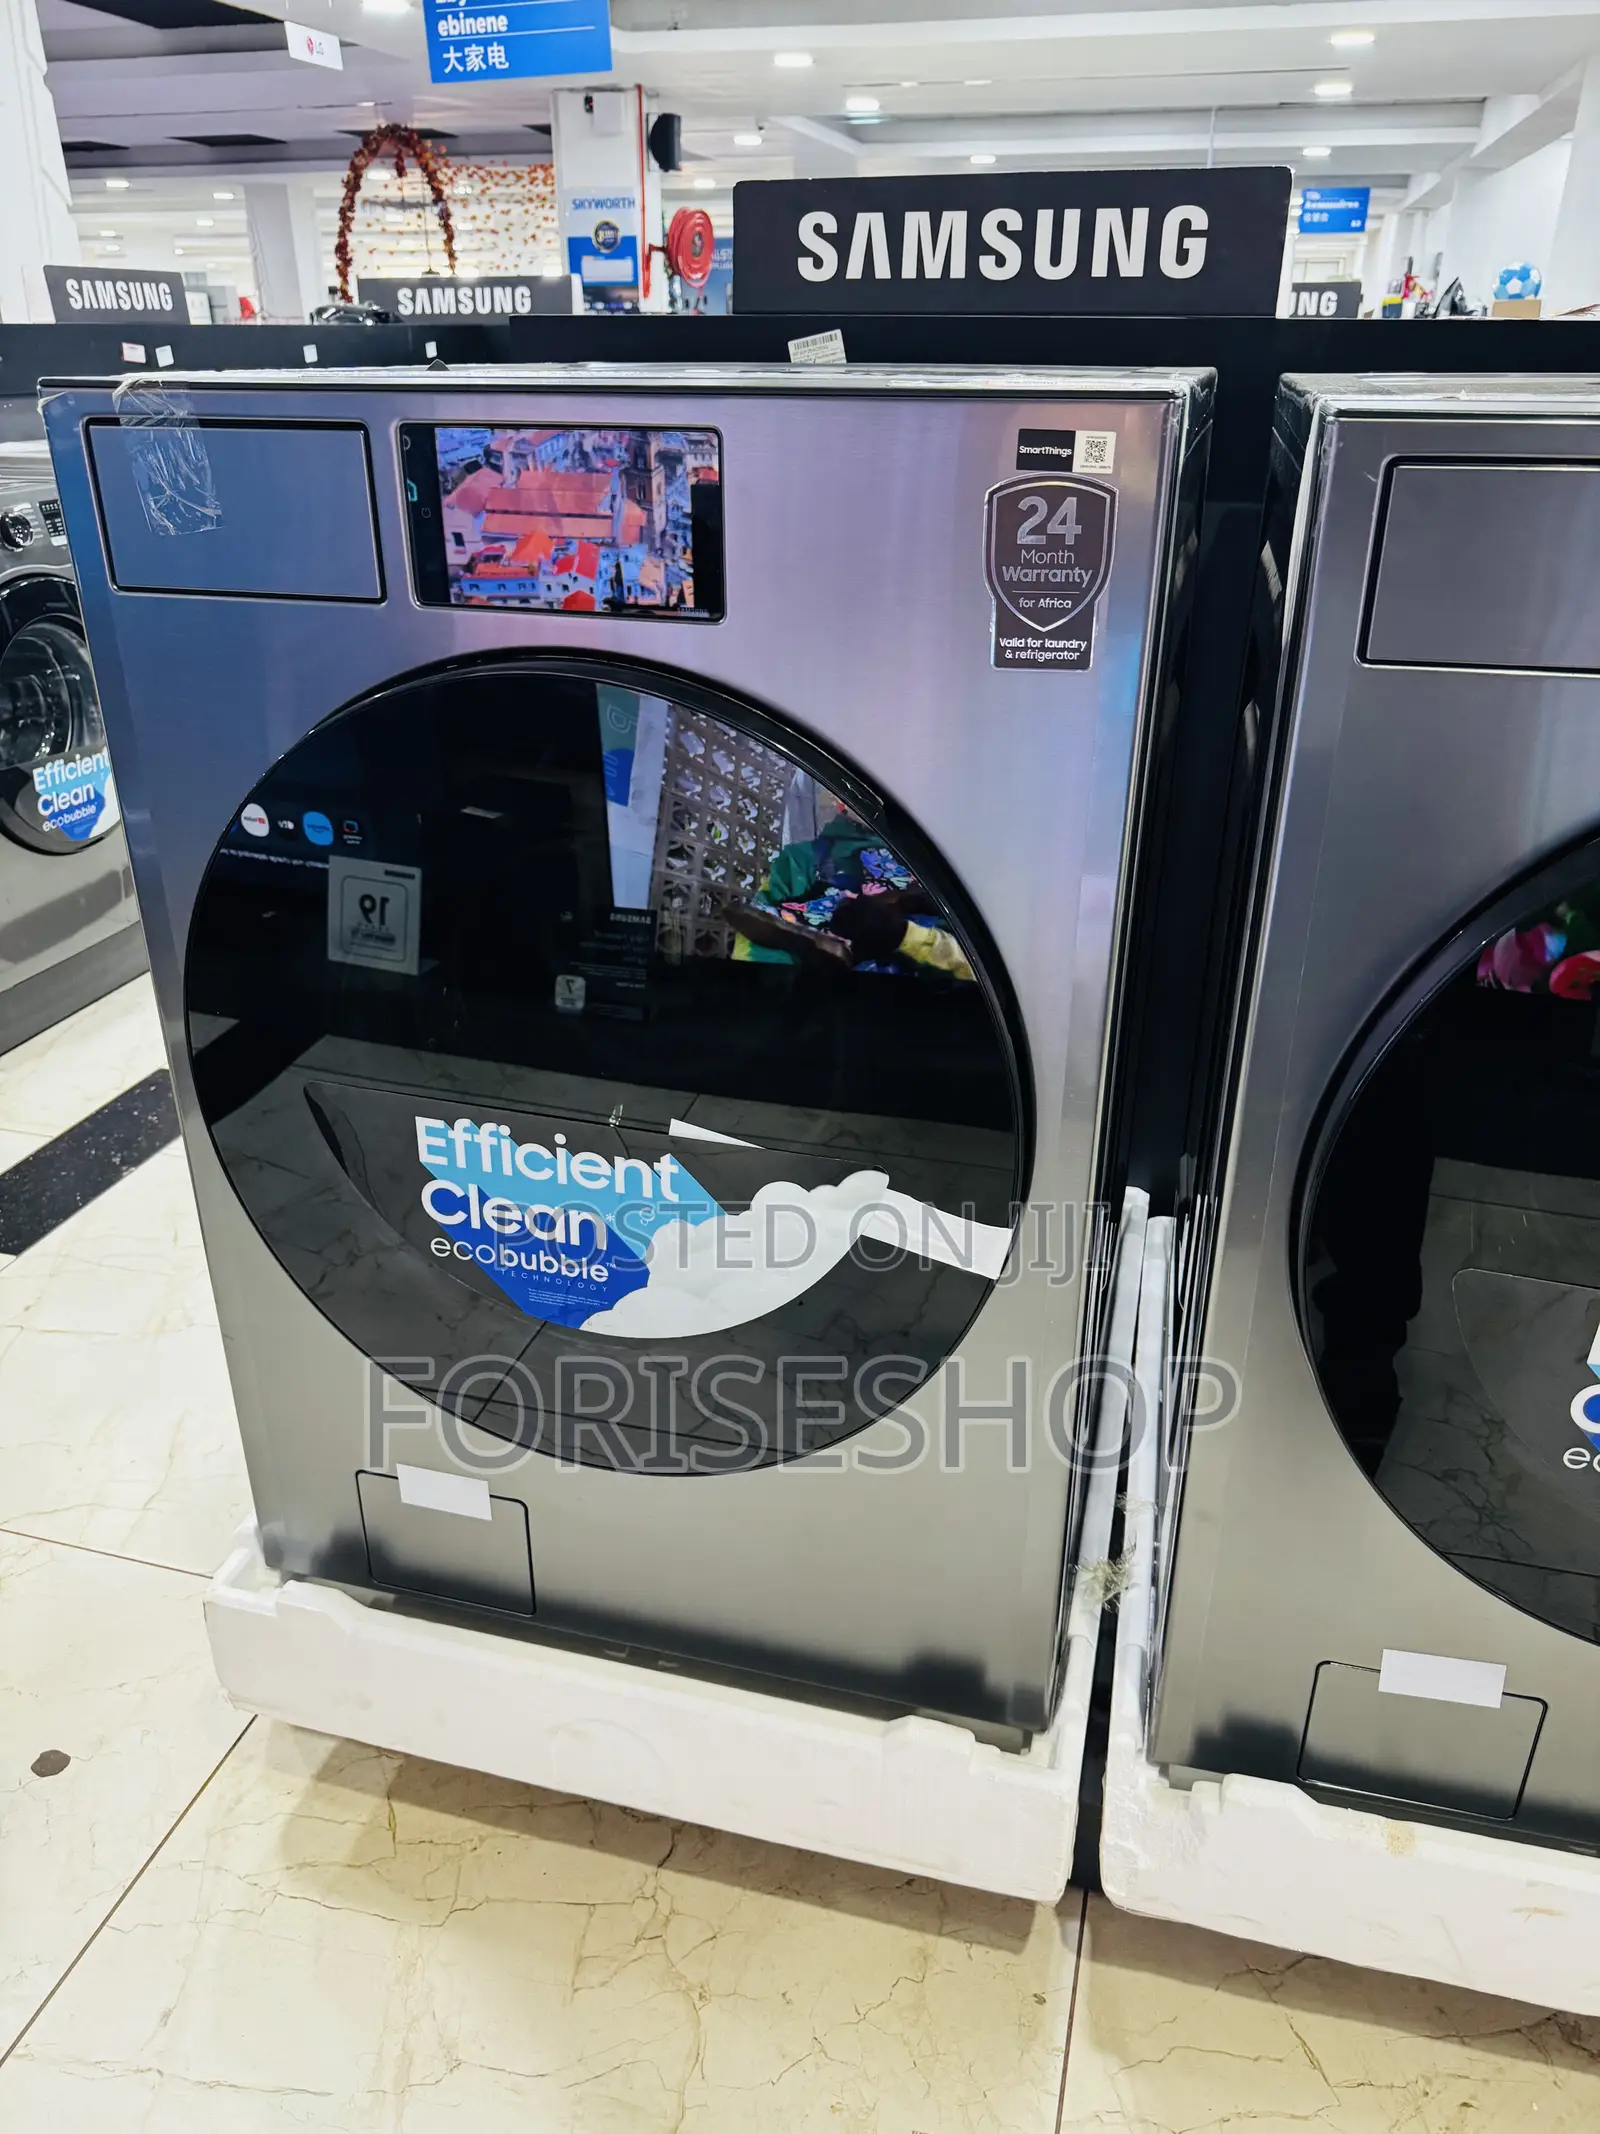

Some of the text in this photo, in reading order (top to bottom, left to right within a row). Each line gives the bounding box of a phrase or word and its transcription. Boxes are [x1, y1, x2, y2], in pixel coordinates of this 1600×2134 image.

[437, 12, 508, 37] ebinene
[442, 42, 509, 73] 大家电
[571, 197, 635, 210] SKYWORTH
[797, 204, 1209, 283] SAMSUNG
[65, 278, 174, 311] SAMSUNG
[397, 285, 532, 315] SAMSUNG
[1018, 445, 1073, 458] SmartThings
[1016, 495, 1083, 545] 24
[1020, 549, 1076, 565] Month
[1001, 565, 1093, 588] Warranty
[1018, 597, 1073, 609] for Africa
[999, 637, 1088, 652] Valid for laundry
[1004, 649, 1081, 662] & refrigerator
[415, 1115, 680, 1203] Efficient
[501, 1268, 609, 1293] TECHNOLOGY
